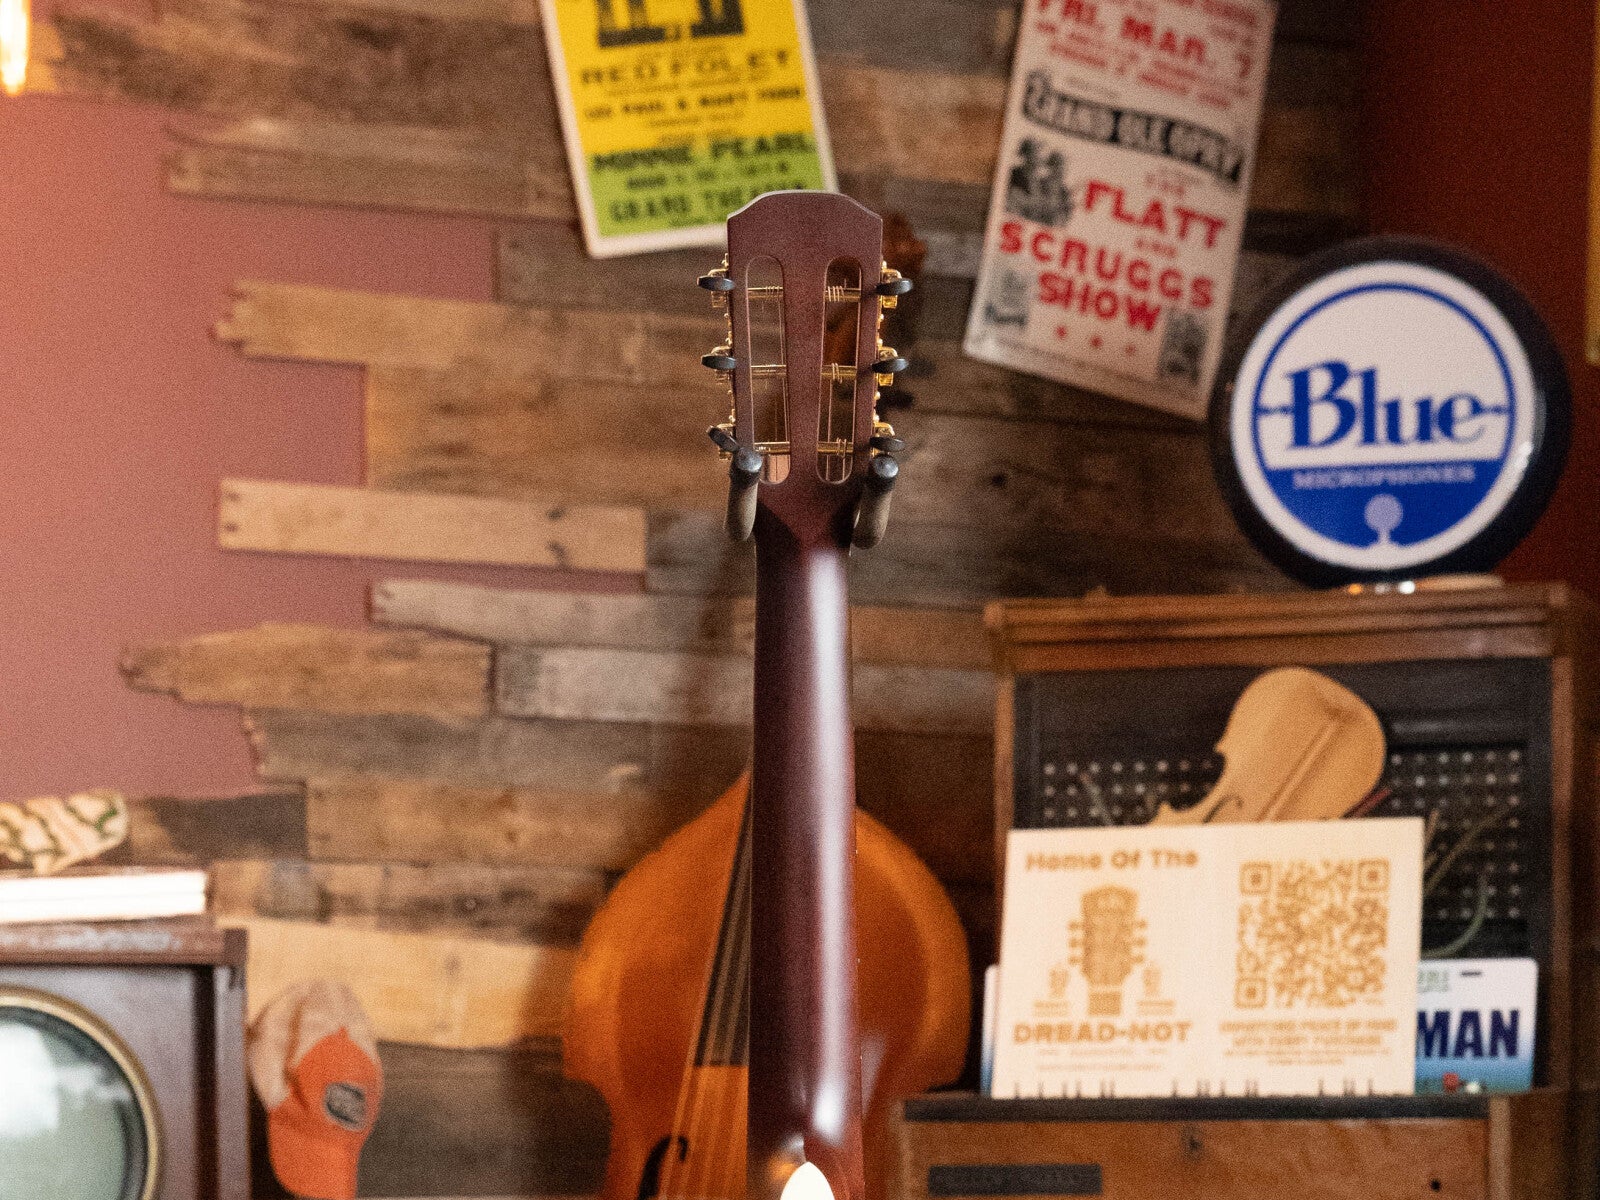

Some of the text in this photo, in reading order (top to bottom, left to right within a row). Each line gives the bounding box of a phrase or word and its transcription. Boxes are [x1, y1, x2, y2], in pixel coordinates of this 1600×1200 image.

[1083, 179, 1228, 249] FLATT
[1000, 220, 1214, 309] SCRUGGS
[1038, 271, 1162, 333] SHOW
[1286, 359, 1486, 450] Blue
[1025, 847, 1199, 872] Home Of The
[1013, 1020, 1193, 1044] DREAD-NOT
